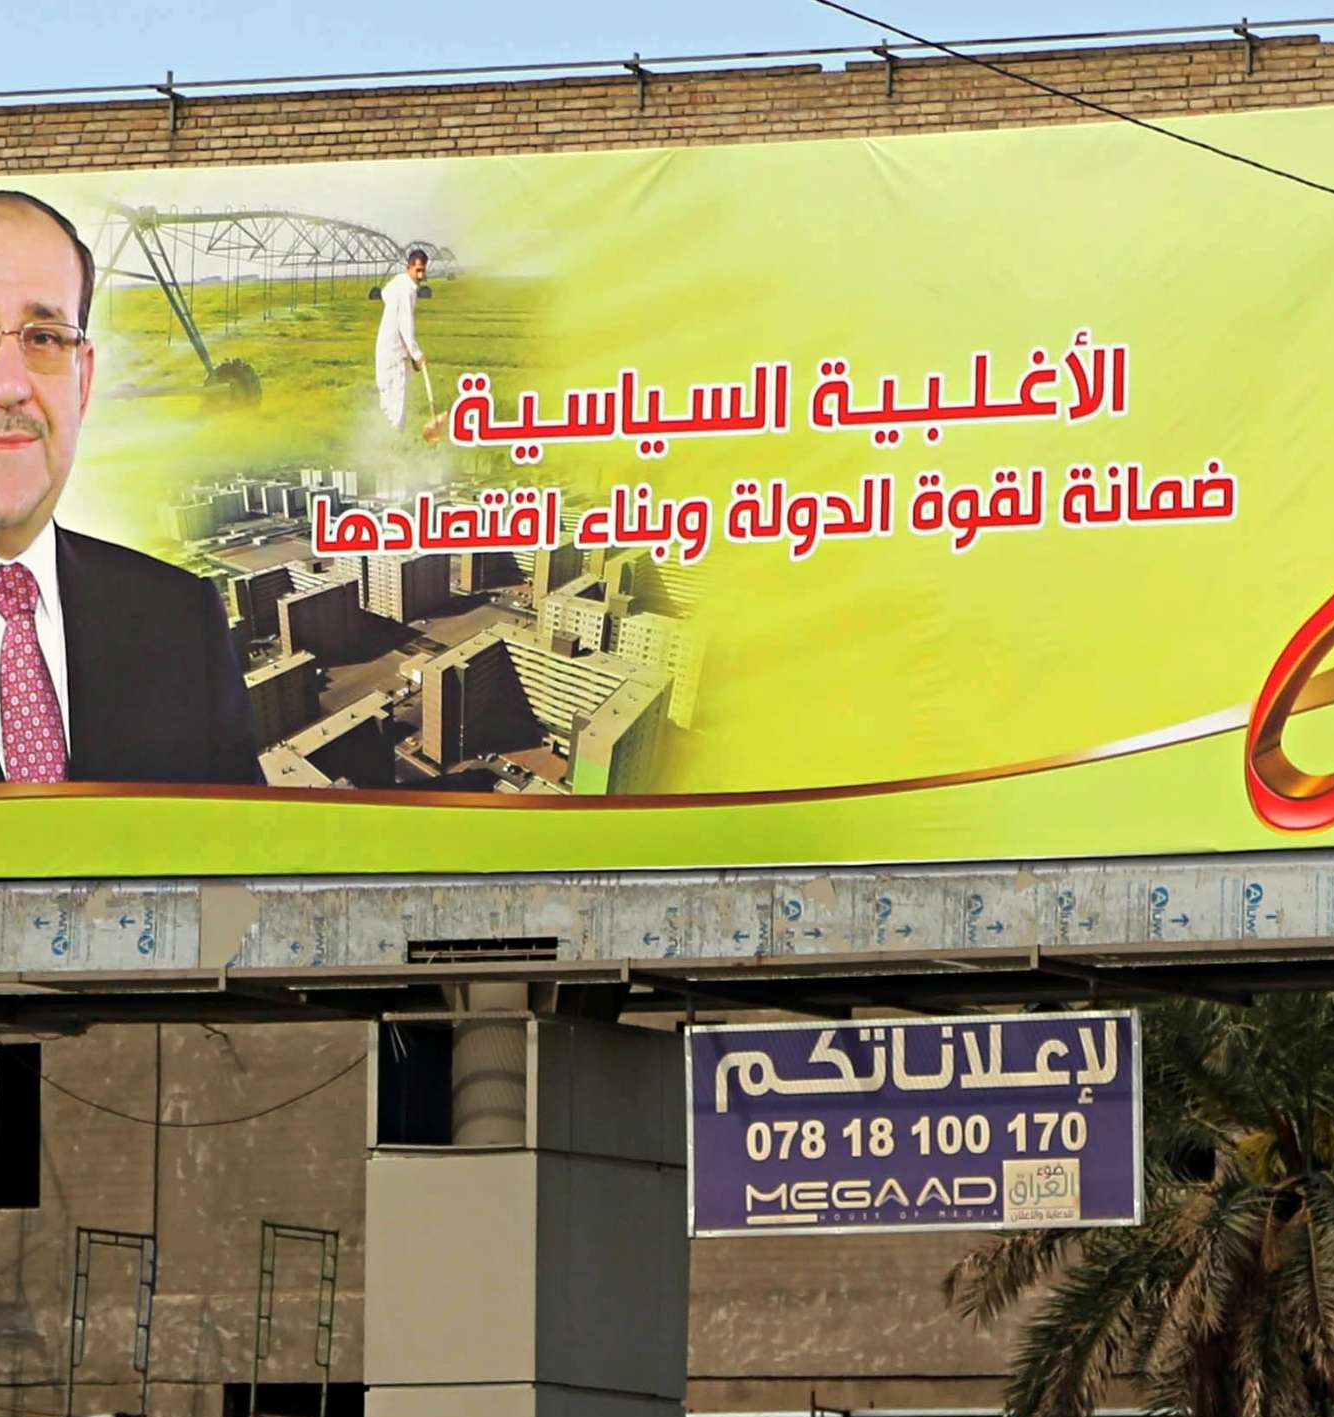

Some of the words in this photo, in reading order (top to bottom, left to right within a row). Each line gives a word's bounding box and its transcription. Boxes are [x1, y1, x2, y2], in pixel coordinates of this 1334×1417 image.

[452, 365, 789, 460] السياسية
[812, 331, 1127, 446] الأغلبية
[314, 490, 557, 553] اقتصادها
[578, 488, 709, 561] وبناء
[729, 478, 891, 556] الدولة
[911, 470, 1044, 549] لقوة
[1062, 462, 1235, 526] ضمانة
[715, 1020, 1119, 1114] لإعلاناتكم
[746, 1119, 826, 1161] 078
[842, 1117, 895, 1158] 18
[911, 1114, 991, 1155] 100
[1007, 1111, 1088, 1152] 170
[1009, 1172, 1075, 1205] العراق
